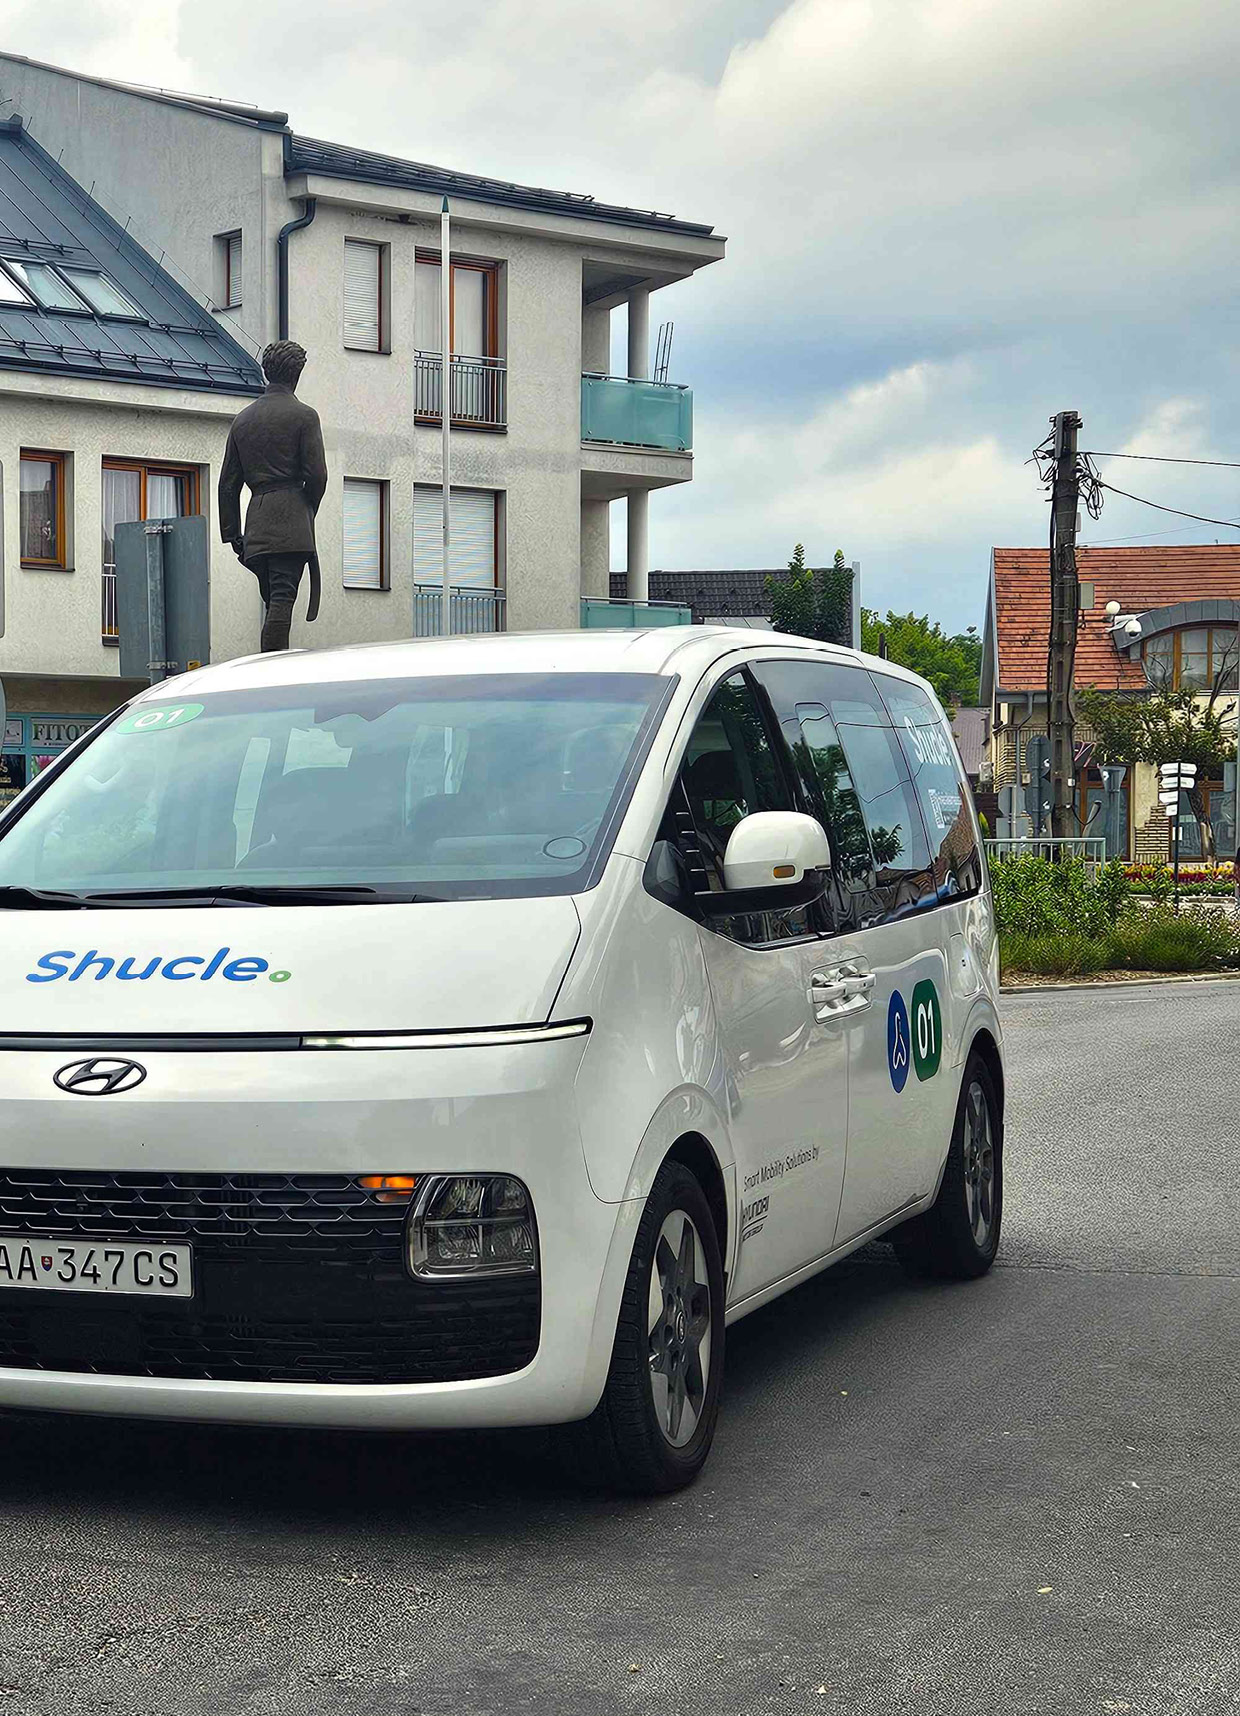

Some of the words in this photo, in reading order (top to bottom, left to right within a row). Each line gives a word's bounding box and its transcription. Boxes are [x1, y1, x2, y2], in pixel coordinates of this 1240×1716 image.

[134, 708, 185, 728] 01
[26, 946, 269, 983] Shucle
[918, 1000, 935, 1059] 01
[57, 1247, 179, 1288] 347CS
